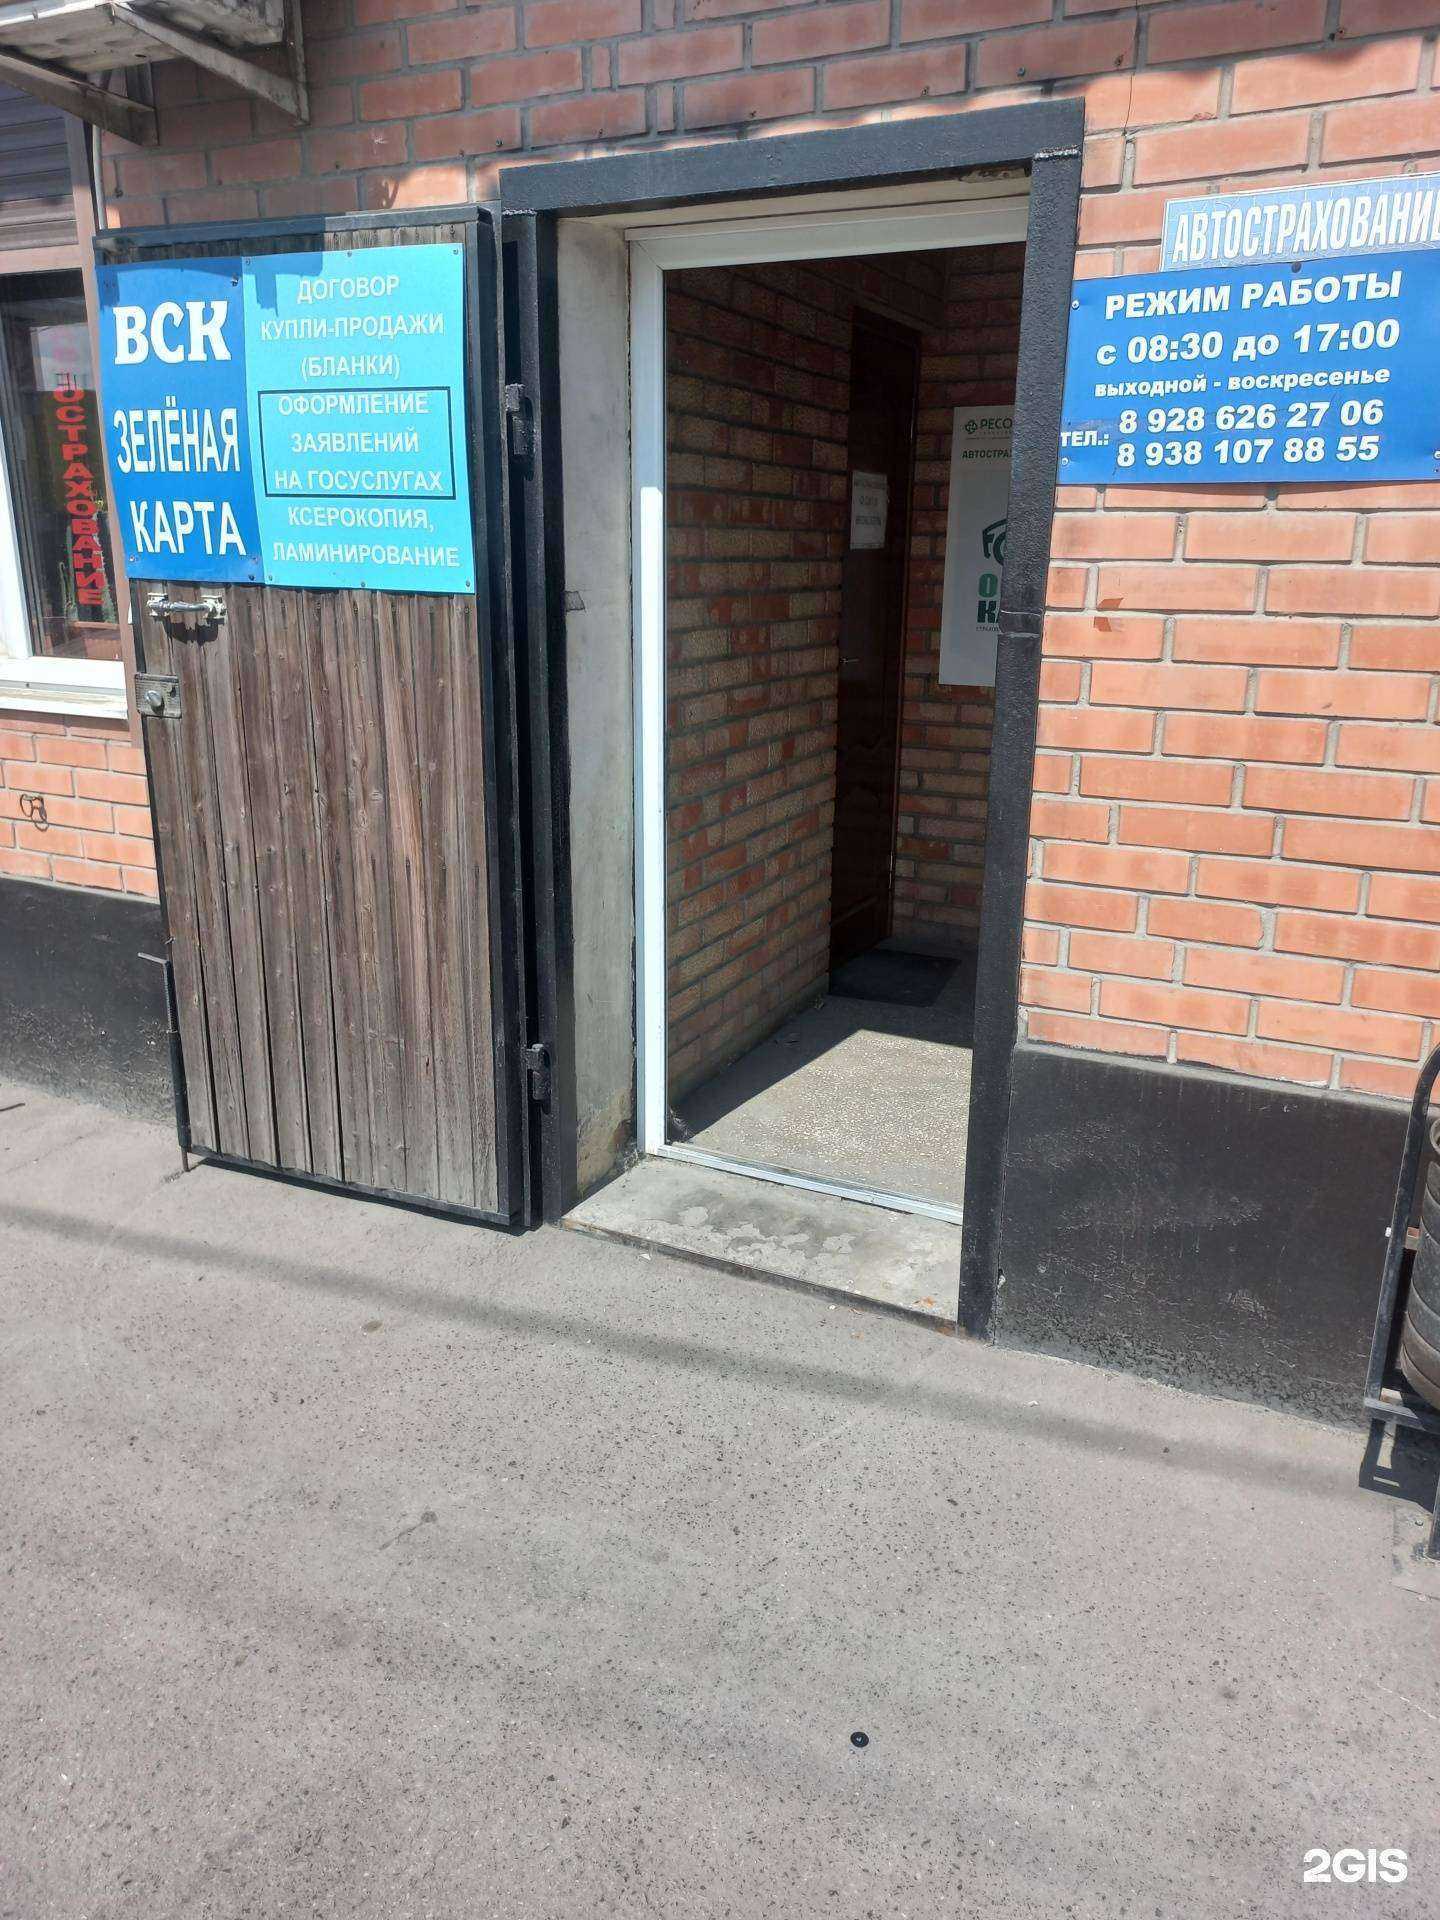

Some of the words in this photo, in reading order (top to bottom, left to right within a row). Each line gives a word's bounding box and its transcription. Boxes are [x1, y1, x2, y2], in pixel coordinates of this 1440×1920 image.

[297, 275, 400, 303] ДОГОВОР
[1104, 285, 1231, 320] РЕЖИМ
[1241, 270, 1402, 309] РАБОТЫ
[112, 300, 232, 366] ВСК
[261, 312, 445, 342] КУПЛИ-ПРОДАЖИ
[1127, 330, 1224, 363] 08:30
[1231, 333, 1280, 362] до
[1292, 318, 1401, 354] 17:00
[301, 355, 400, 382] (БЛАНКИ)
[1094, 373, 1208, 398] выходной
[1227, 368, 1390, 392] воскресенье
[278, 391, 430, 417] ОФОРМЛЕНИЕ
[1118, 409, 1139, 434] 8
[1147, 406, 1205, 433] 928
[1215, 403, 1277, 431] 626
[1286, 401, 1332, 428] 27
[1339, 399, 1385, 426] 06
[113, 396, 241, 474] ЗЕЛЁНАЯ
[980, 418, 1013, 430] РЕСО
[291, 426, 419, 454] ЗАЯВЛЕНИЙ
[1060, 431, 1110, 447] ТЕЛ.:
[1116, 443, 1136, 468] 8
[1144, 440, 1203, 467] 938
[1213, 438, 1274, 465] 107
[1283, 436, 1326, 463] 88
[1335, 435, 1380, 462] 55
[274, 472, 300, 491] НА
[307, 470, 443, 492] ГОСУСЛУГАХ
[129, 500, 247, 556] КАРТА
[287, 505, 435, 532] КСЕРОКОПИЯ,
[272, 541, 461, 568] ЛАМИНИРОВАНИЕ
[977, 600, 1001, 624] К
